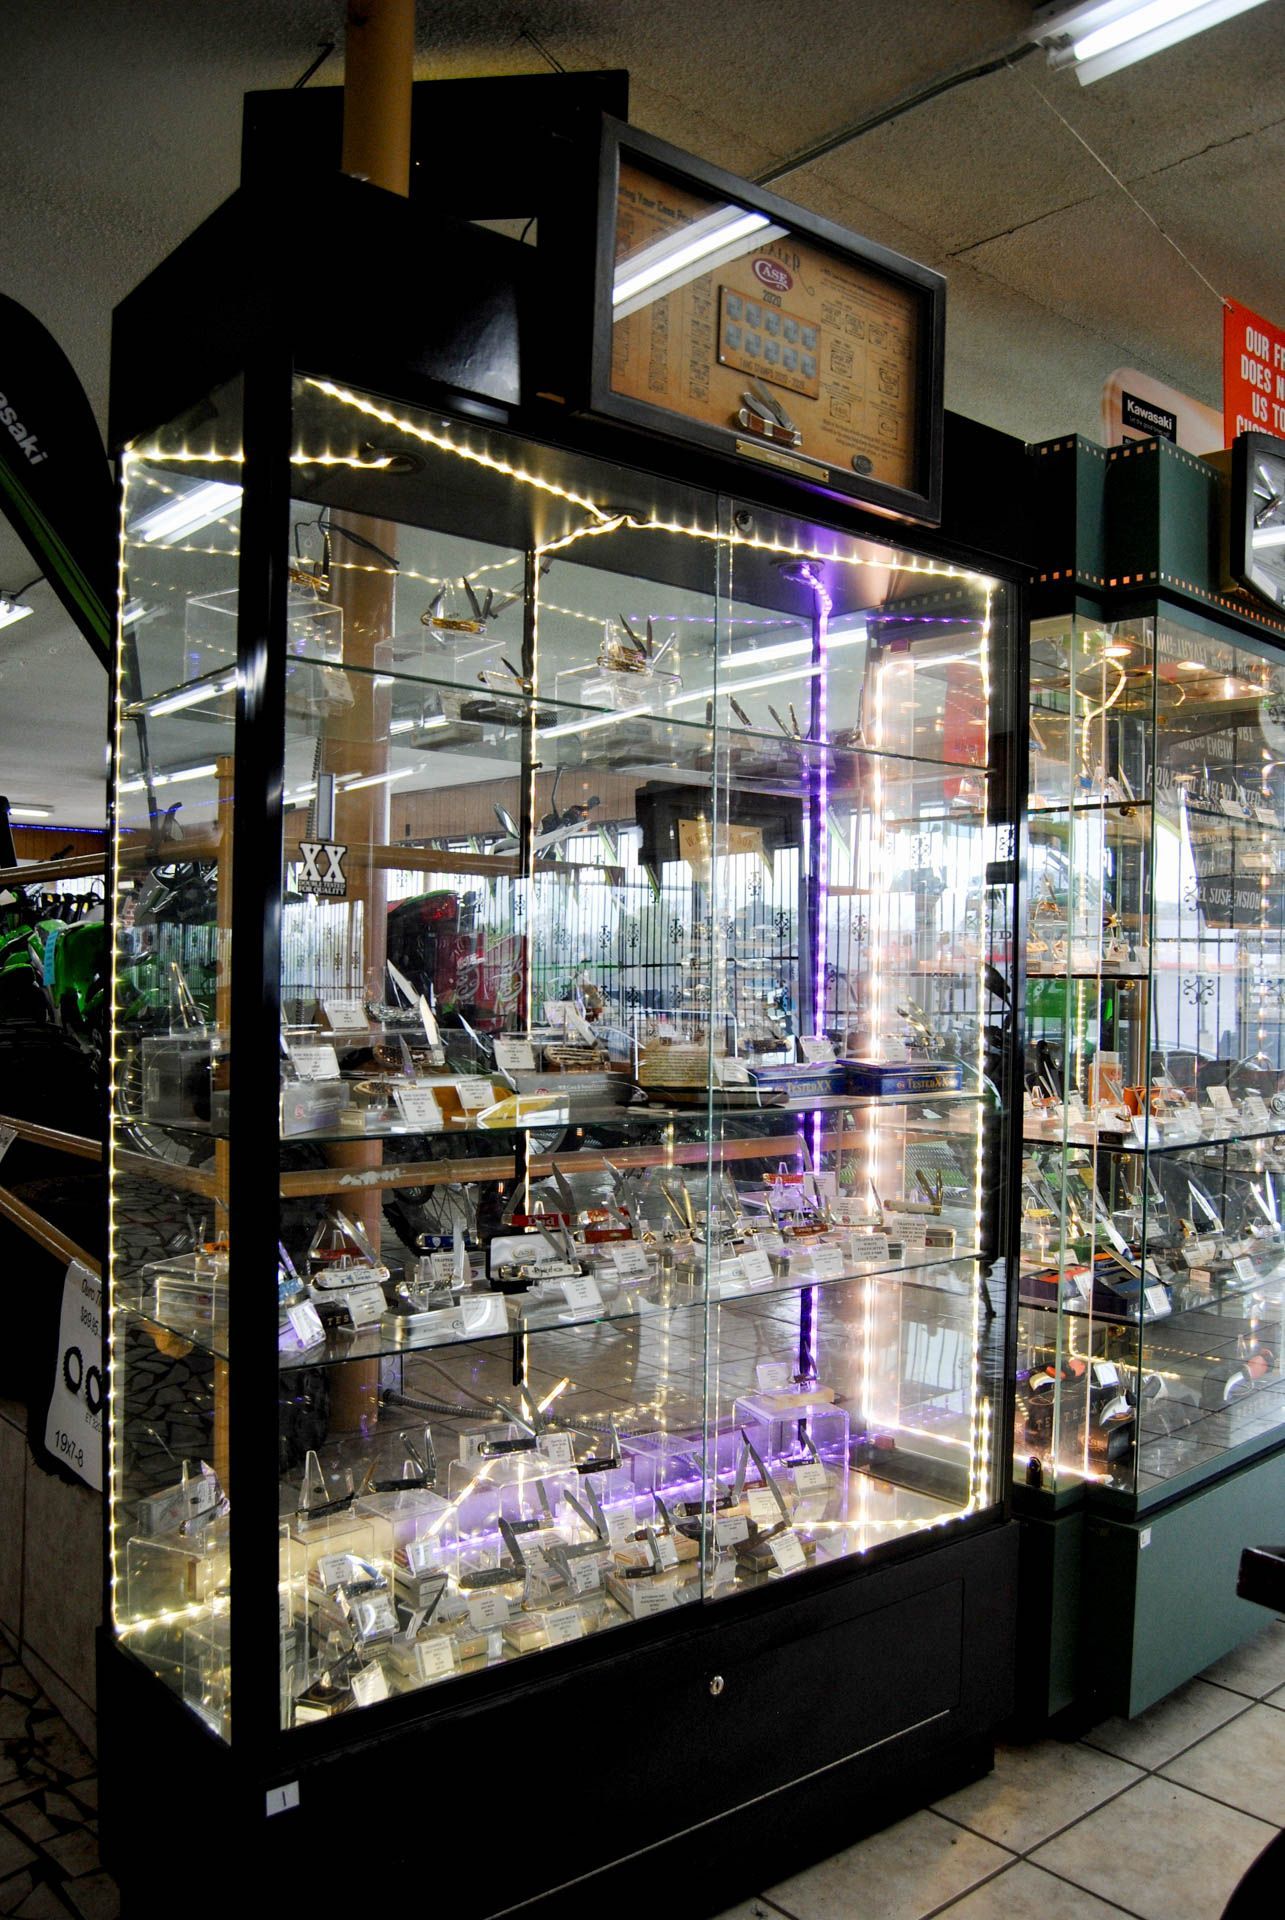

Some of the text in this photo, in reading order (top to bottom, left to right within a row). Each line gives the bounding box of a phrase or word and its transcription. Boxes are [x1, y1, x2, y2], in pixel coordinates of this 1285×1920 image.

[1245, 325, 1270, 363] OUR
[1241, 354, 1272, 394] DOES
[1126, 399, 1173, 431] Kawasaki
[1251, 391, 1268, 423] US
[299, 843, 347, 883] XX
[299, 885, 345, 896] FOR QUALITY
